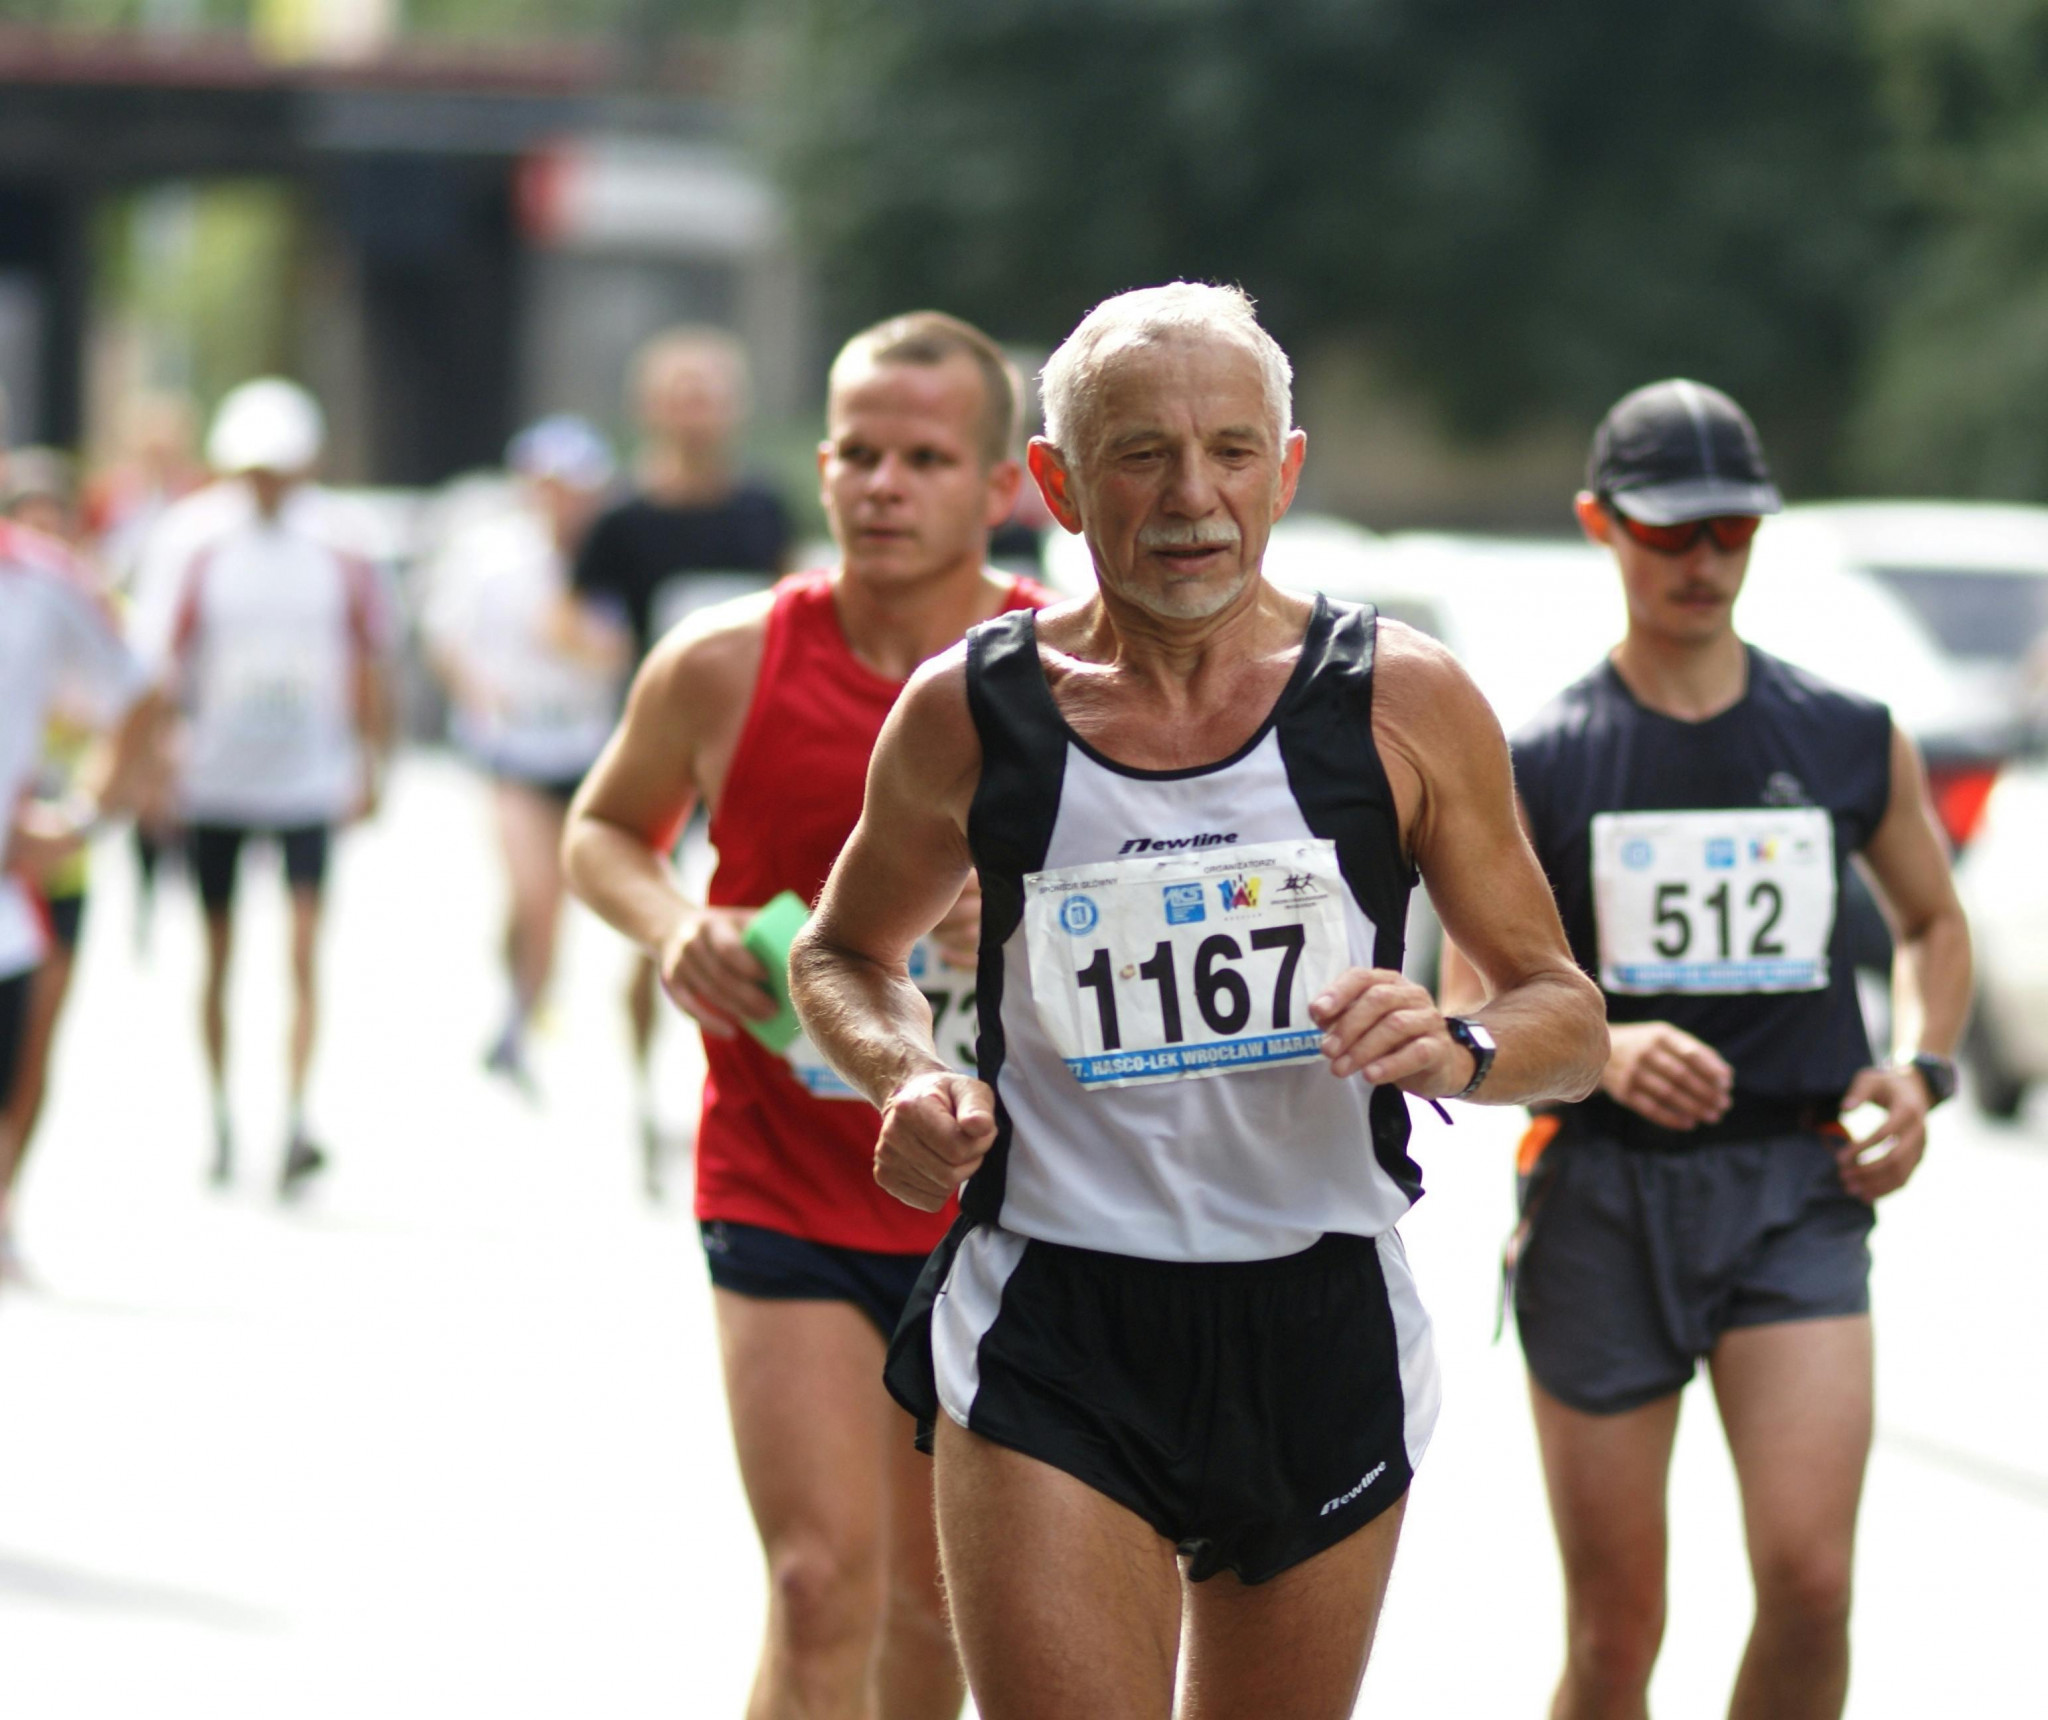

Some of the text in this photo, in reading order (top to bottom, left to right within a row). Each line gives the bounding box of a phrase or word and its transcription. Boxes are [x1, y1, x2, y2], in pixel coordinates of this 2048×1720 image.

[1652, 881, 1786, 960] 512
[1076, 923, 1306, 1052] 1167
[1091, 1052, 1179, 1077] HASCO-LEK
